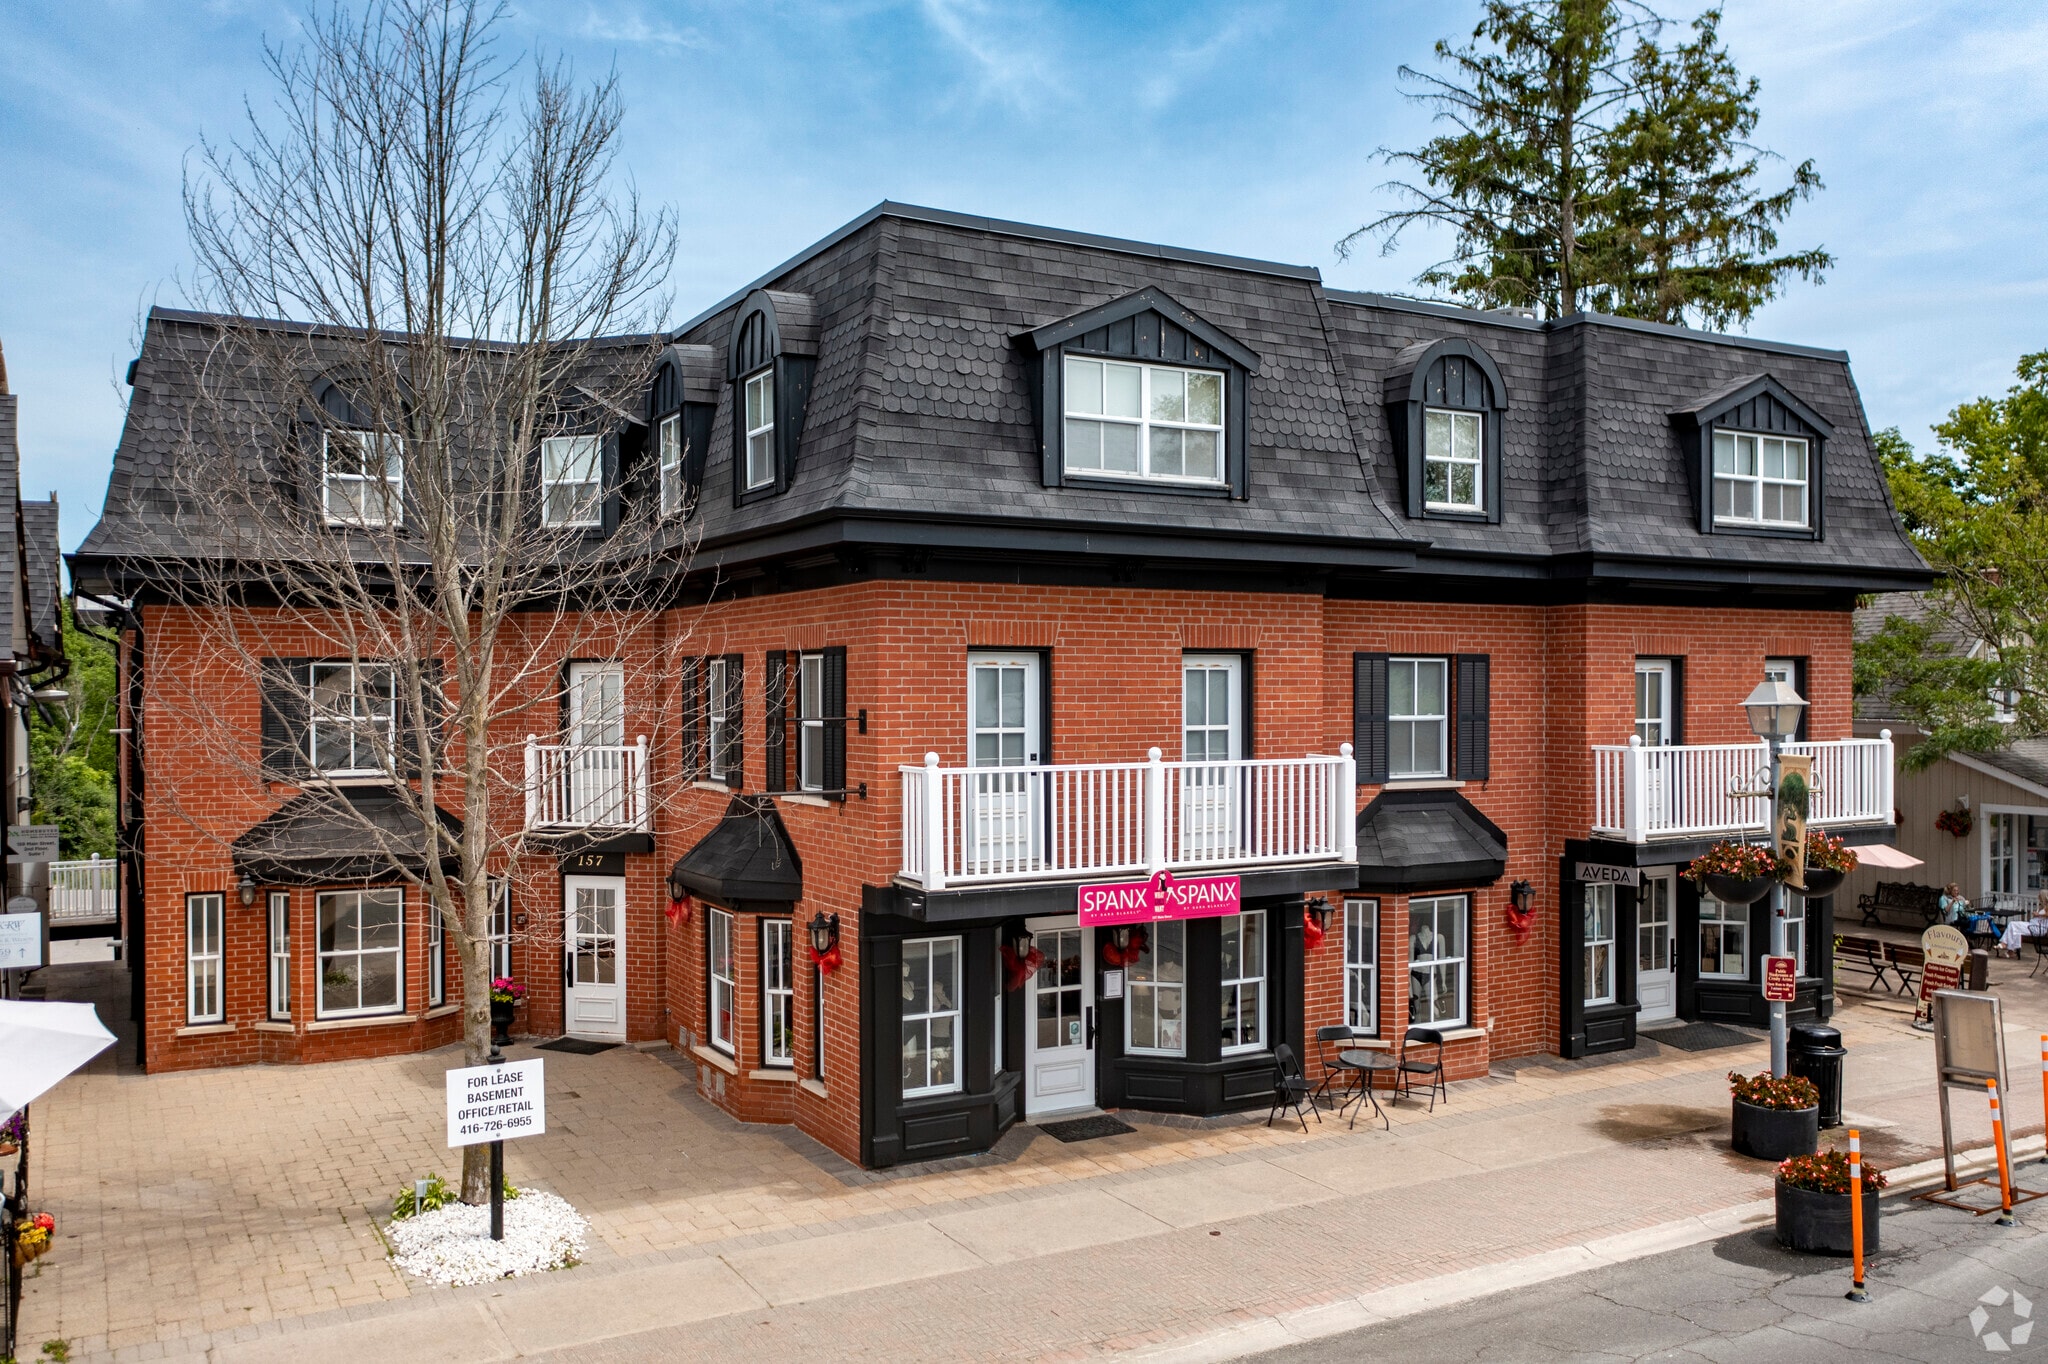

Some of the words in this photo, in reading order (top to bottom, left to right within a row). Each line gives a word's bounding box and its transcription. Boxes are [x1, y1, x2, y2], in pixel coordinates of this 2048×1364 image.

[578, 855, 604, 867] 157
[1582, 866, 1630, 882] AVEDA
[1084, 888, 1148, 912] SPANX
[1177, 882, 1237, 904] SPANX
[1927, 930, 1963, 945] Flavours
[467, 1076, 488, 1088] FOR
[491, 1072, 523, 1085] LEASE
[467, 1087, 524, 1104] BASEMENT
[458, 1101, 533, 1120] OFFICE/RETAIL
[460, 1116, 532, 1135] 416-726-6955
